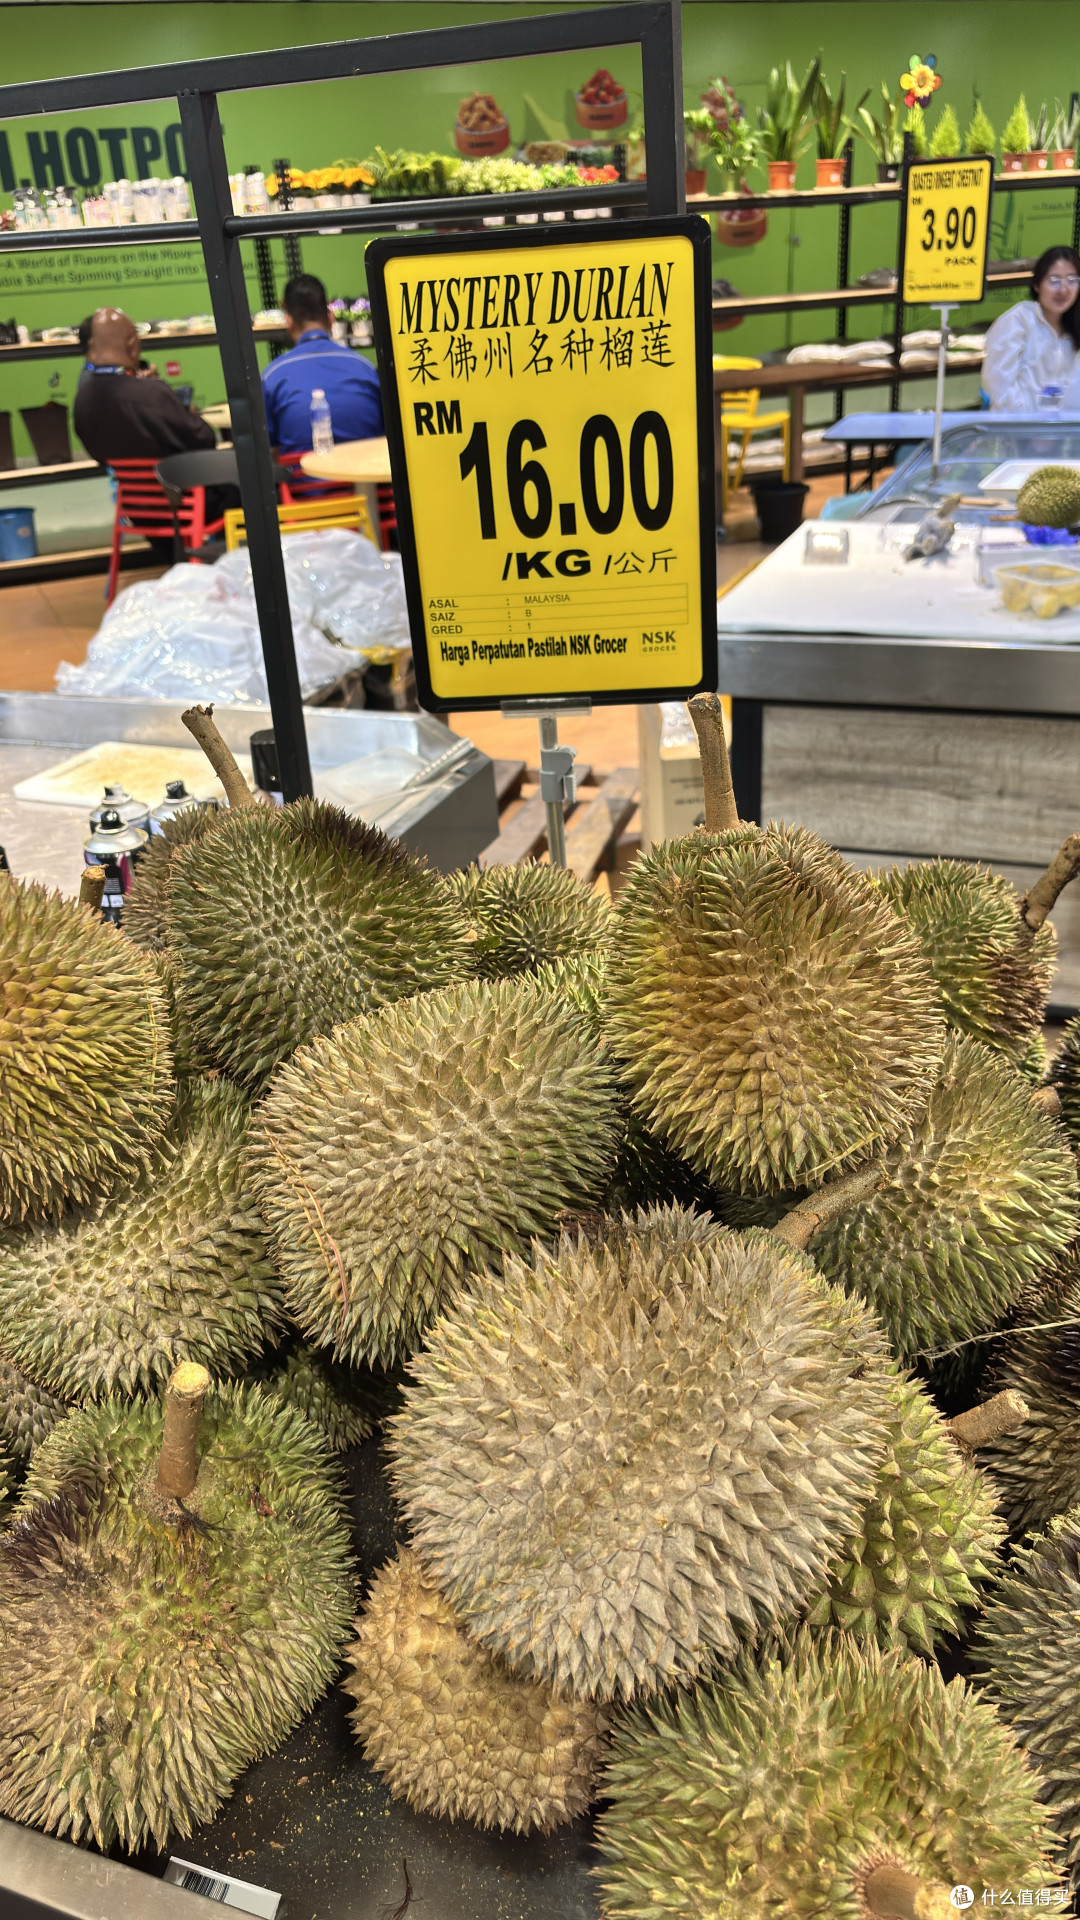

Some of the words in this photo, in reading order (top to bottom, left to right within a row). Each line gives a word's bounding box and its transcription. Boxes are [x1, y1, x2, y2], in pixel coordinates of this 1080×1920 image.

[921, 206, 976, 251] 3.90
[17, 256, 55, 269] World
[57, 254, 71, 267] of
[73, 252, 119, 266] Flavors
[120, 252, 135, 263] on
[137, 249, 157, 261] the
[944, 255, 977, 267] PACK
[67, 269, 122, 284] Spinning
[124, 265, 172, 280] Straight
[398, 272, 544, 335] MYSTERY
[547, 262, 675, 325] DURIAN
[408, 319, 676, 386] 柔佛州名种榴莲
[413, 400, 463, 436] RM
[459, 410, 674, 540] 16.00
[502, 549, 592, 581] /KG
[429, 599, 459, 609] ASAL
[524, 594, 571, 604] MALAYSIA
[430, 612, 455, 621] SAIZ
[525, 609, 532, 617] B
[431, 625, 463, 634] GRED
[642, 631, 677, 644] NSK
[440, 641, 470, 666] Harga
[471, 640, 526, 664] Perpatutan
[527, 636, 568, 657] Pastilah
[569, 634, 592, 655] NSK
[594, 633, 627, 655] Grocer
